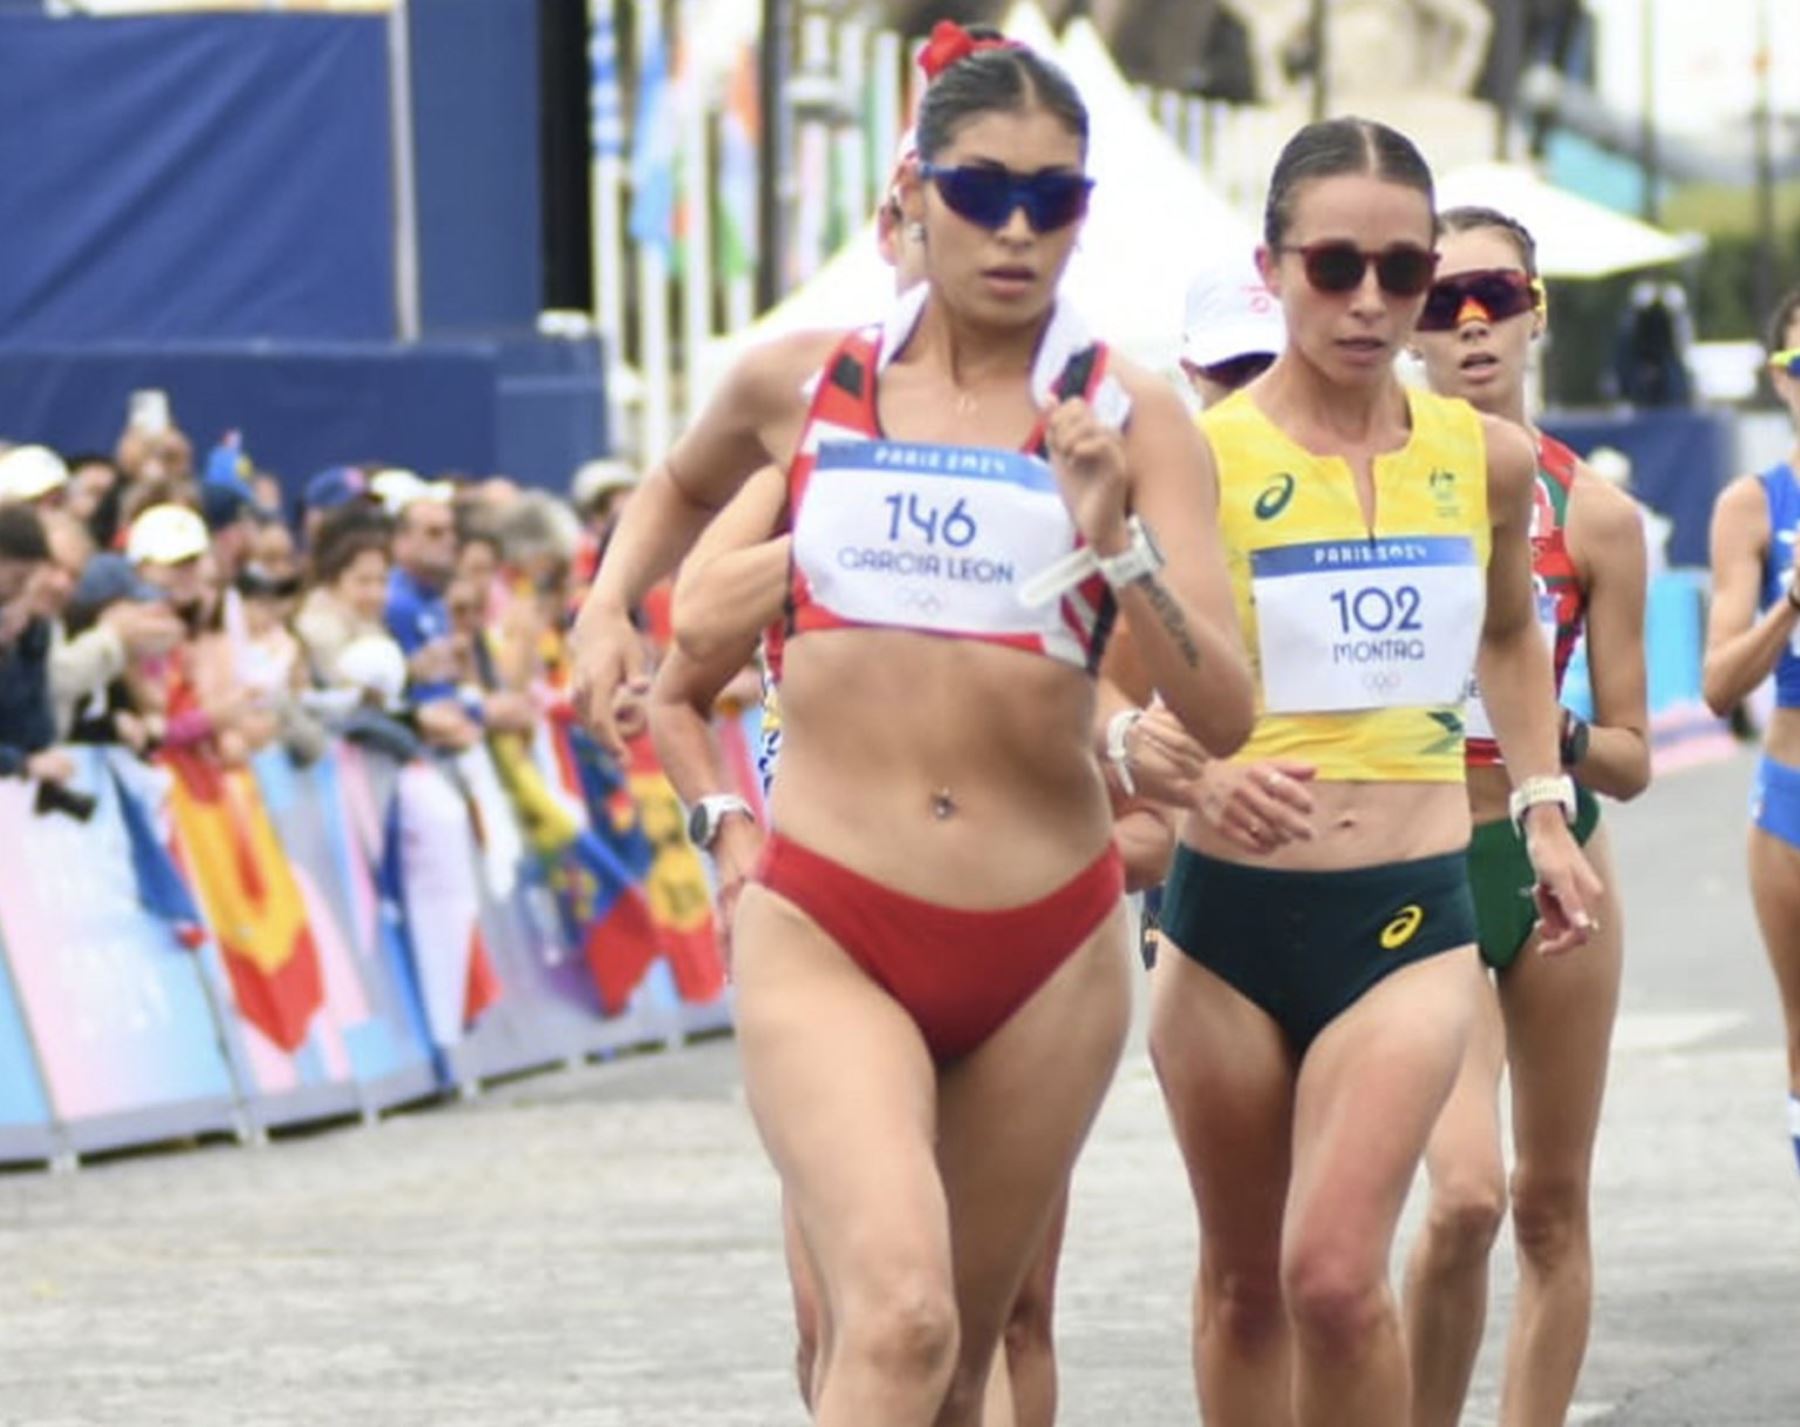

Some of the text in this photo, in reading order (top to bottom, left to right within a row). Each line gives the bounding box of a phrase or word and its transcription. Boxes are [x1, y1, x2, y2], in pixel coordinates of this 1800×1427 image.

[884, 492, 977, 548] 146
[837, 547, 1014, 583] GARCIA LEON
[1330, 585, 1422, 633] 102
[1333, 639, 1425, 663] MONTAG
